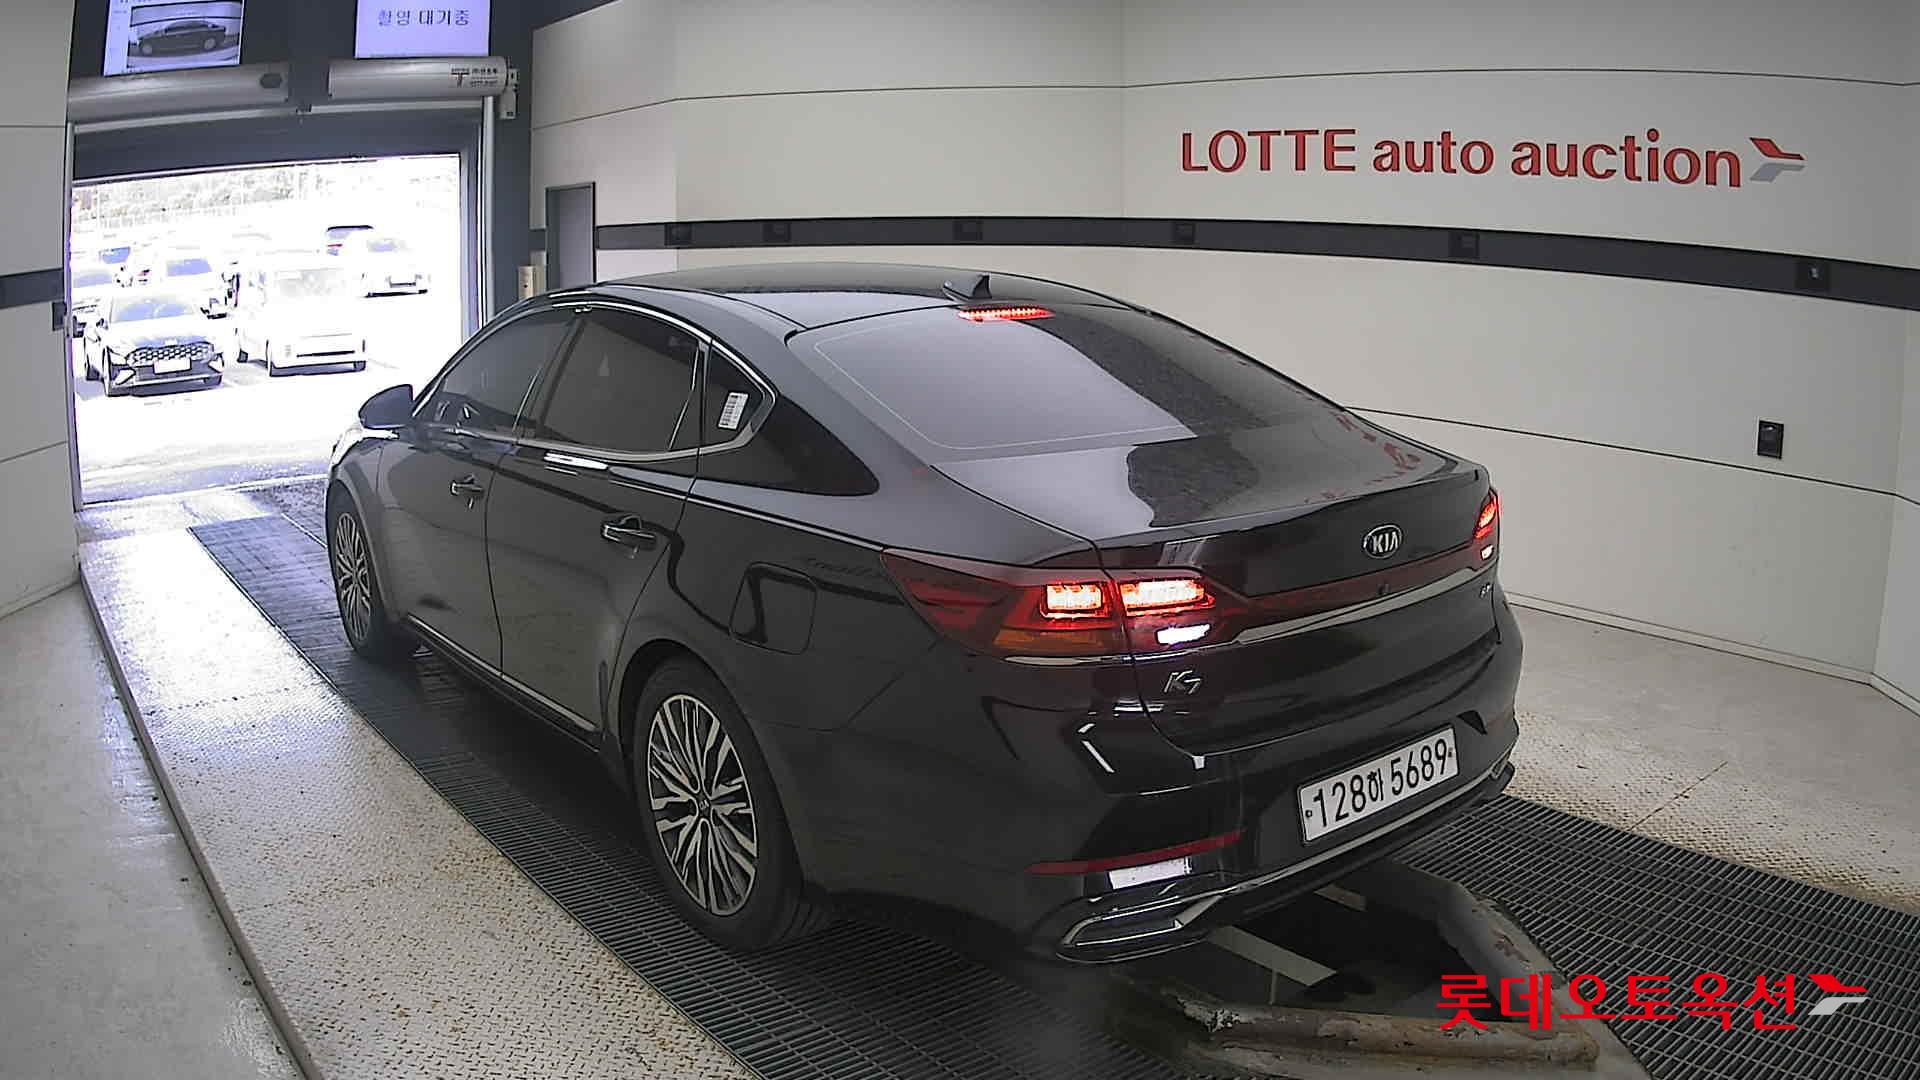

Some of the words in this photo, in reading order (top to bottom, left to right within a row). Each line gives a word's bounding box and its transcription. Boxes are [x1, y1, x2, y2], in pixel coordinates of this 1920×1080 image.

[419, 9, 469, 26] 대기중
[1182, 129, 1356, 173] LOTTE
[1372, 131, 1495, 174] auto
[1511, 128, 1741, 188] auction
[1373, 531, 1399, 554] KIA
[1163, 670, 1201, 695] K7
[1313, 768, 1384, 827] 128하
[1391, 739, 1448, 796] 5689
